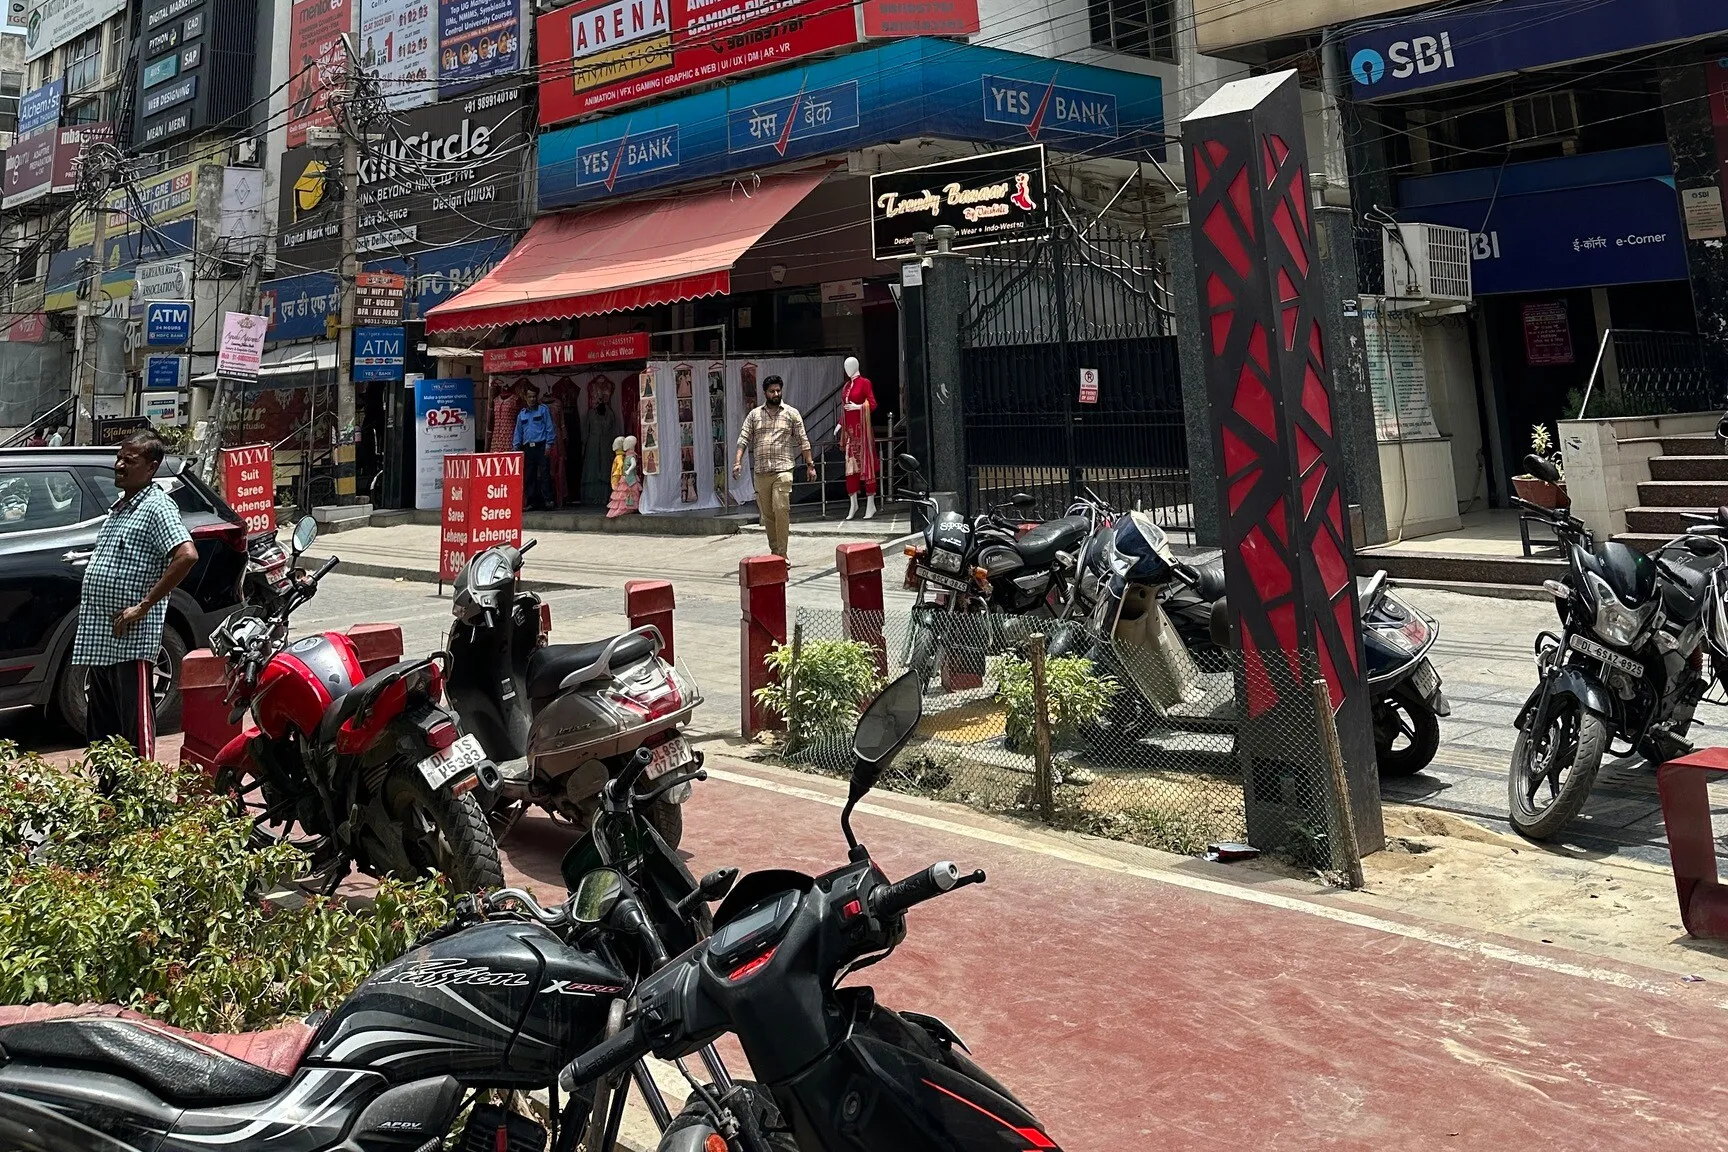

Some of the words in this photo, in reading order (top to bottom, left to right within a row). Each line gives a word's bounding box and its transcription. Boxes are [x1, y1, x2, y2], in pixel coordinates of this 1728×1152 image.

[149, 6, 169, 26] DIGITAL
[450, 6, 460, 14] Top
[7, 15, 27, 24] TGC
[187, 17, 199, 31] CAD
[444, 24, 464, 36] Central
[464, 16, 491, 30] University
[491, 9, 513, 21] Courses
[149, 31, 169, 50] PYTHON
[184, 49, 197, 66] SAP
[376, 55, 387, 67] AIR
[1388, 31, 1455, 79] SBI
[584, 90, 616, 107] ANIMATION
[620, 85, 632, 96] VFX
[636, 78, 661, 93] GAMING
[664, 70, 693, 85] GRAPHIC
[700, 62, 717, 76] WEB
[160, 83, 190, 106] DESIGNING
[464, 102, 476, 114] +91
[991, 87, 1031, 115] YES
[1056, 97, 1111, 128] BANK
[749, 109, 777, 139] येस
[804, 94, 833, 128] बैंक
[146, 125, 163, 142] MEAN
[168, 115, 186, 132] MERN
[582, 150, 609, 175] YES
[628, 135, 673, 166] BANK
[155, 182, 169, 198] GRE
[175, 174, 189, 190] SSC
[377, 181, 412, 202] BEYOND
[152, 200, 169, 214] CLAT
[432, 193, 462, 211] Design
[957, 227, 978, 236] Wear
[1616, 233, 1667, 247] e-Corner
[356, 287, 368, 295] NID
[388, 289, 403, 297] NATA
[281, 300, 296, 323] एच
[296, 290, 309, 317] डी
[310, 294, 327, 318] एफ
[375, 299, 395, 307] UCEED
[151, 309, 187, 323] ATM
[372, 308, 382, 316] JEE
[382, 309, 399, 317] ARCH
[362, 340, 399, 355] ATM
[542, 344, 574, 364] MYM
[619, 348, 634, 356] Wear
[229, 448, 269, 468] MYM
[445, 459, 471, 479] MYM
[475, 456, 521, 478] MYM
[240, 470, 260, 482] Suit
[237, 484, 264, 498] Saree
[451, 486, 463, 501] Suit
[487, 484, 508, 499] Suit
[448, 507, 465, 523] Saree
[481, 506, 512, 521] Saree
[443, 528, 468, 546] Lehenga
[472, 528, 518, 543] Lehenga
[1581, 641, 1592, 652] DL
[430, 752, 450, 768] DL
